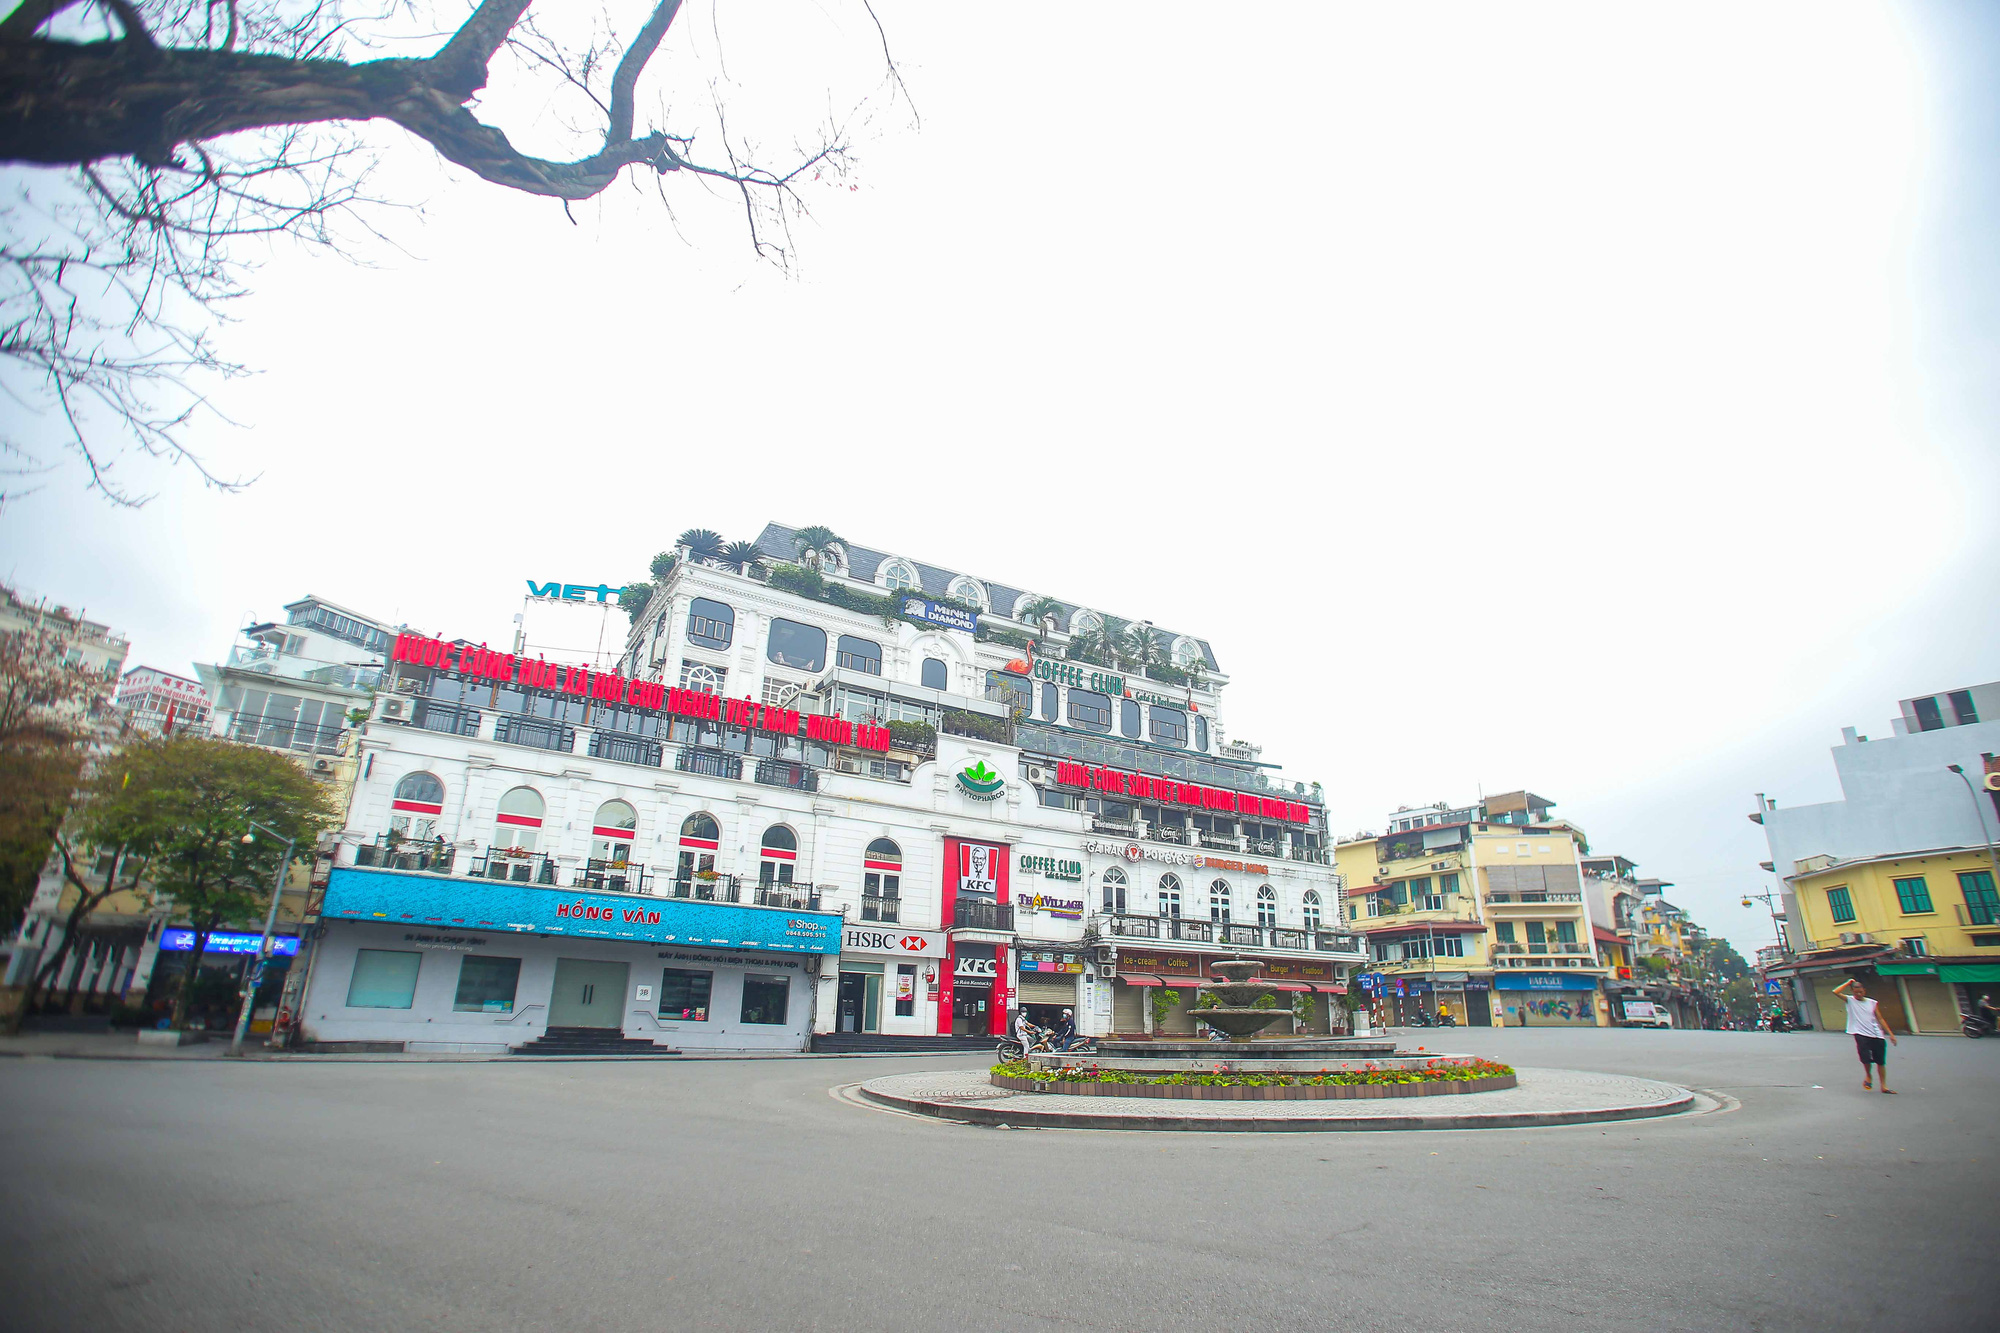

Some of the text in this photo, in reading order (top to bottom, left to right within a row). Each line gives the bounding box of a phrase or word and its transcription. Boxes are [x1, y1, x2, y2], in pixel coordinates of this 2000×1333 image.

[928, 611, 975, 629] DIAMOND
[934, 604, 970, 620] MINH
[1034, 659, 1122, 695] COFFEE CLUB
[392, 632, 890, 752] NƯỚC CỘNG HÒA XÃ HỘI CHỦ NGHĨA VIỆT NAM MUÔN NĂM
[954, 783, 1005, 802] PHYTOPHARCO
[1057, 756, 1090, 788] ĐẢNG
[1093, 764, 1124, 795] CỘNG
[1128, 769, 1151, 797] SẢN
[1152, 775, 1175, 805] VIỆT
[1177, 782, 1201, 806] NAM
[1202, 787, 1235, 812] QUANG
[1237, 793, 1260, 816] VINH
[1261, 795, 1288, 821] MUÔN
[1020, 855, 1081, 874] COFFEE CLUB
[1205, 857, 1269, 875] BURGER KING
[966, 880, 991, 891] KFC
[556, 899, 613, 921] HỒNG
[622, 907, 661, 924] VÂN
[846, 931, 896, 949] HSBC
[957, 957, 997, 973] KFC
[1168, 957, 1189, 968] Coffee
[1270, 964, 1323, 975] Burger Fastfood
